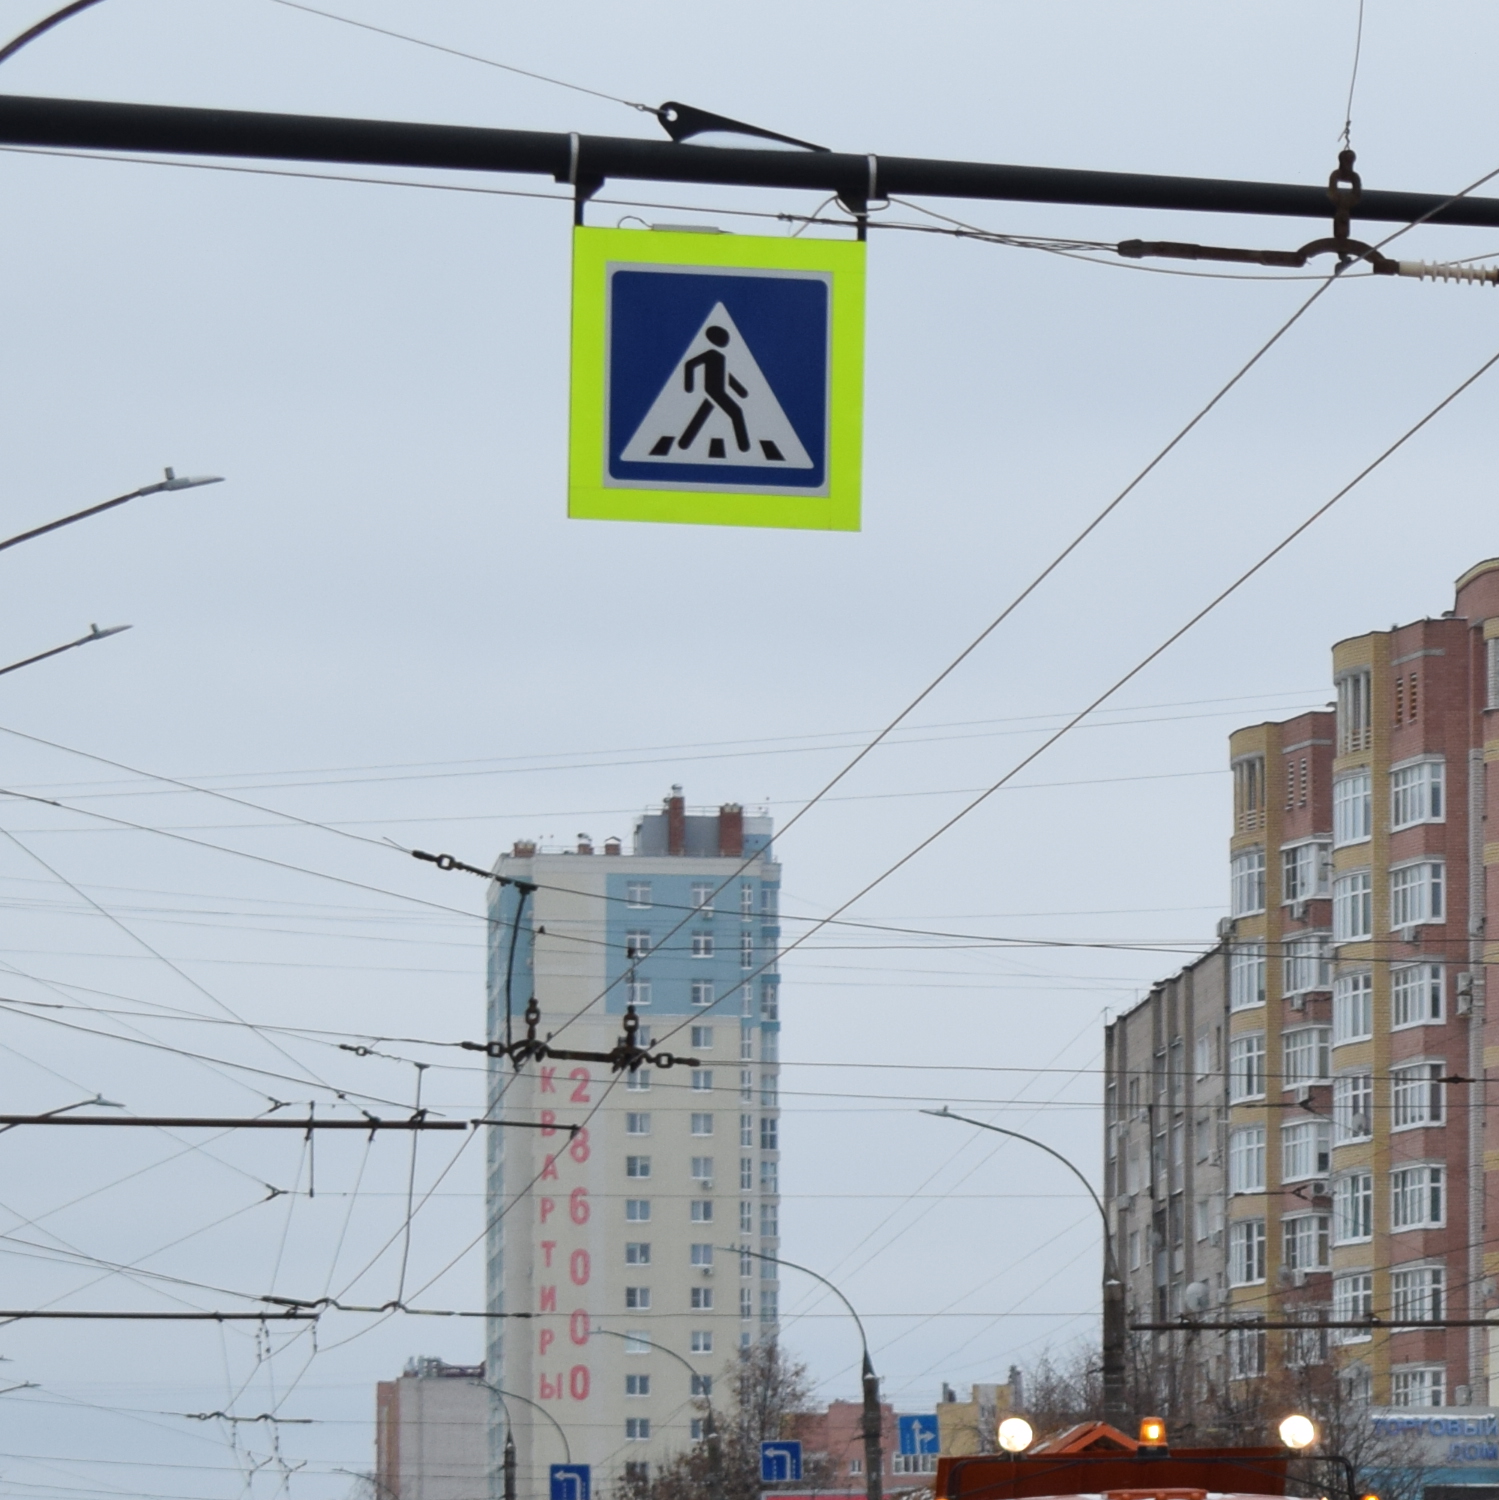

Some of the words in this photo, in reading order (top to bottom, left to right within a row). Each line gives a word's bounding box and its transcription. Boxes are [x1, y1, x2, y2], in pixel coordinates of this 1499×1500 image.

[539, 1066, 563, 1400] КВАРТИРЫ
[569, 1067, 591, 1401] 286000
[1372, 1416, 1498, 1436] ТОРГОВЫЙ
[1449, 1442, 1499, 1462] ДОМ
